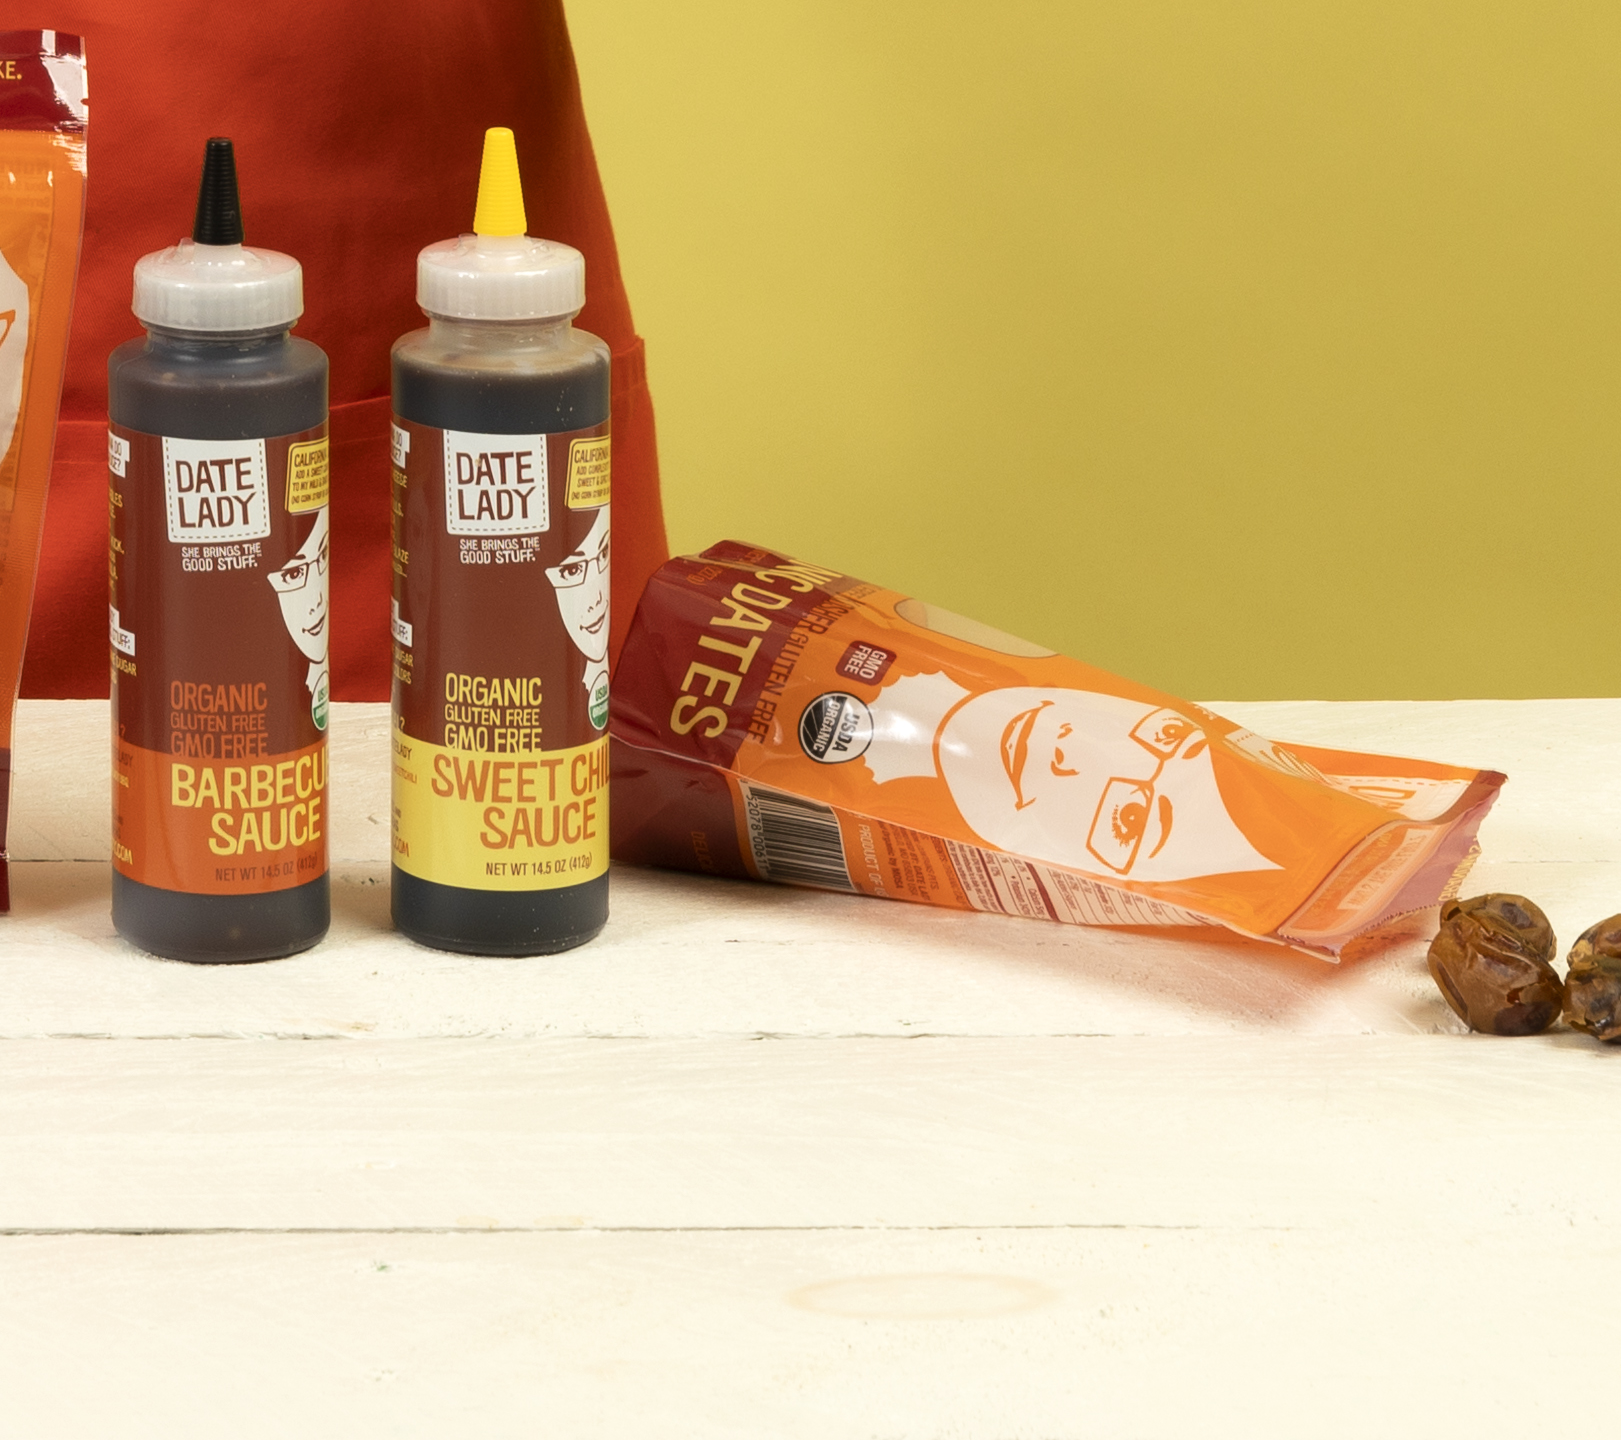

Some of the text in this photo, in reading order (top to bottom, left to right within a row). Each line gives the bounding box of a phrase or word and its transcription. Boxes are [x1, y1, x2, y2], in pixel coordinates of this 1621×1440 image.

[176, 457, 254, 493] DATE
[456, 451, 534, 485] DATE
[178, 492, 256, 528] LADY
[458, 486, 536, 520] LADY
[182, 542, 260, 557] SHE BRINGS THE
[460, 537, 539, 550] SHE BRINGS THE
[460, 551, 491, 564] GOOD
[183, 558, 213, 571] GOOD
[670, 582, 793, 738] DATES
[764, 632, 809, 696] GLUTEN
[844, 645, 869, 675] FREE
[859, 650, 887, 679] GMO
[170, 681, 267, 713] ORGANIC
[446, 672, 542, 706] ORGANIC
[171, 712, 265, 732] GLUTEN FREE
[445, 704, 540, 726] GLUTEN FREE
[747, 701, 777, 744] FREE
[813, 700, 841, 752] ORGANIC
[171, 731, 268, 758] GMO FREE
[445, 724, 542, 753] GMO FREE
[832, 713, 860, 752] USDA
[432, 754, 564, 803] SWEET
[209, 797, 320, 856] SAUCE
[480, 796, 596, 849] SAUCE
[746, 795, 762, 831] 52078
[216, 861, 294, 881] NET WT 14.5 OZ
[486, 852, 592, 876] NET WT 14.5 OZ (412g)
[858, 824, 883, 886] PRODUCT OF
